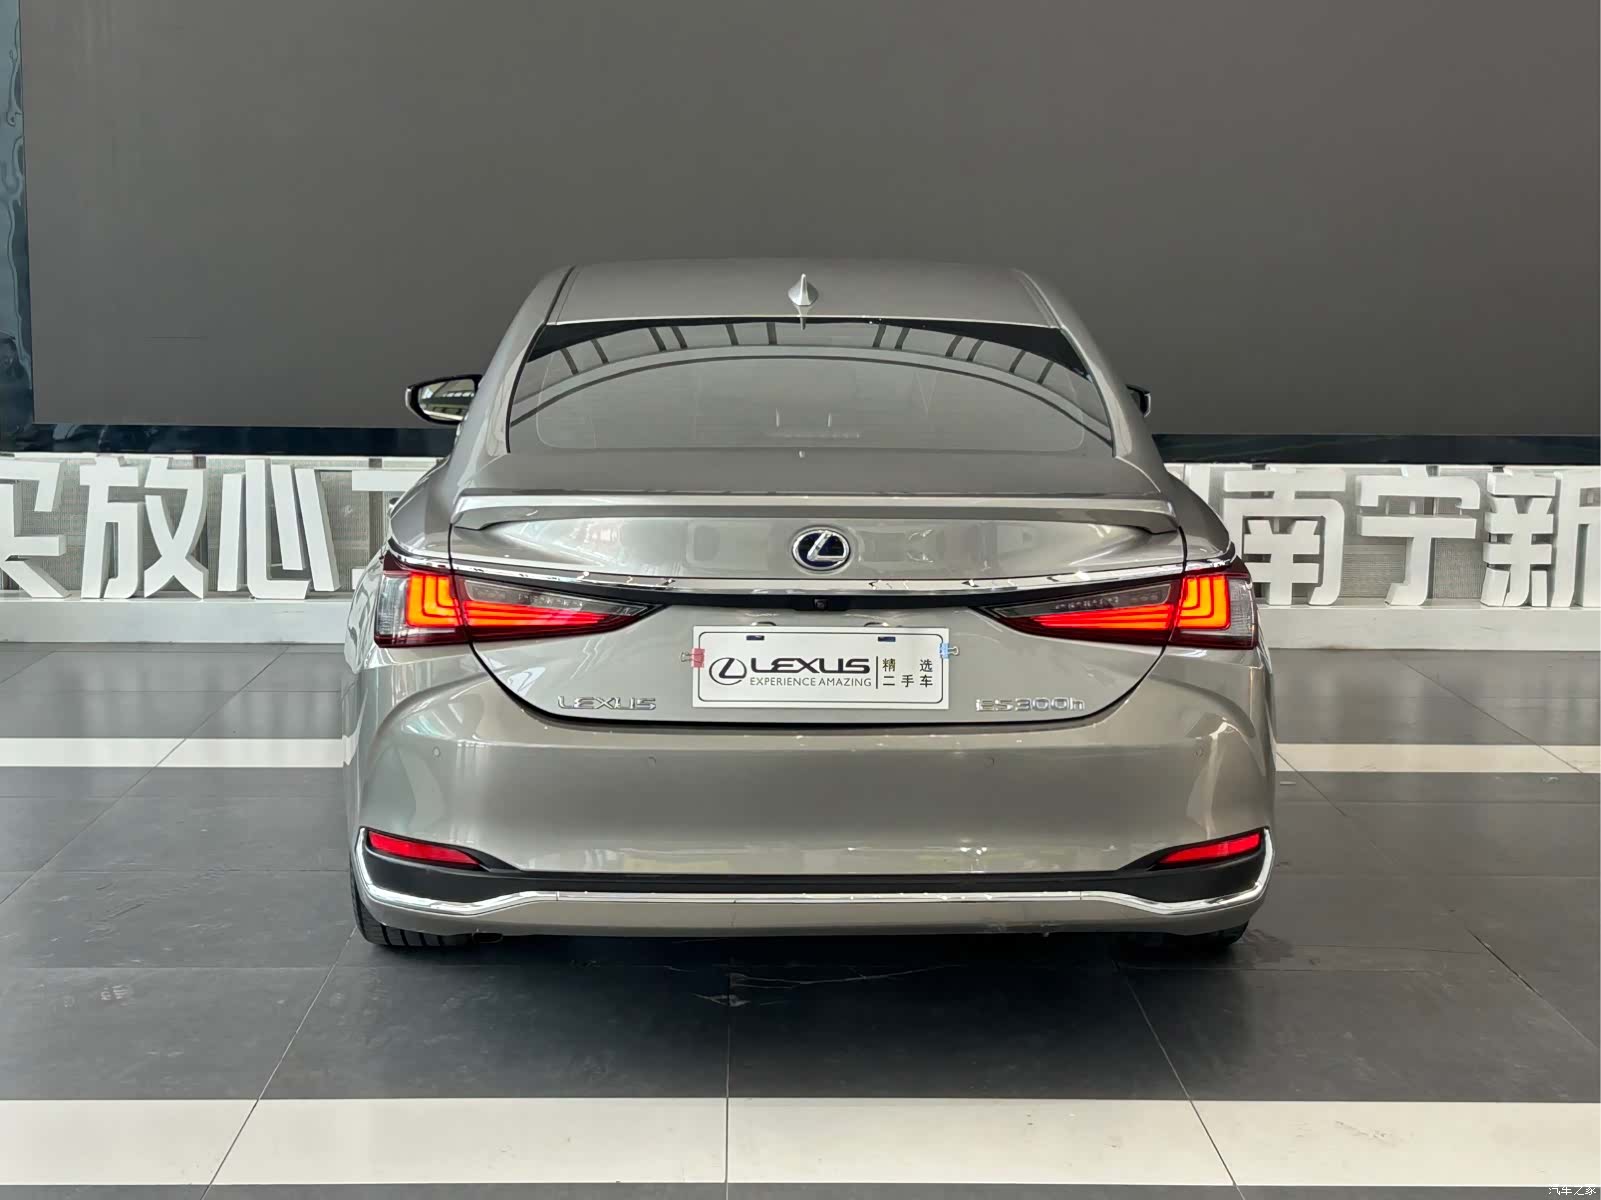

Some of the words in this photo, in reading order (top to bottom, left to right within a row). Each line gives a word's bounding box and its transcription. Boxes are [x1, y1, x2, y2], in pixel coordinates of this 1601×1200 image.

[1186, 464, 1600, 608] 南宁新
[751, 657, 870, 674] LEXUS
[750, 677, 816, 686] EXPERIENCE
[818, 677, 872, 687] AMAZING
[557, 696, 656, 710] LEXUS
